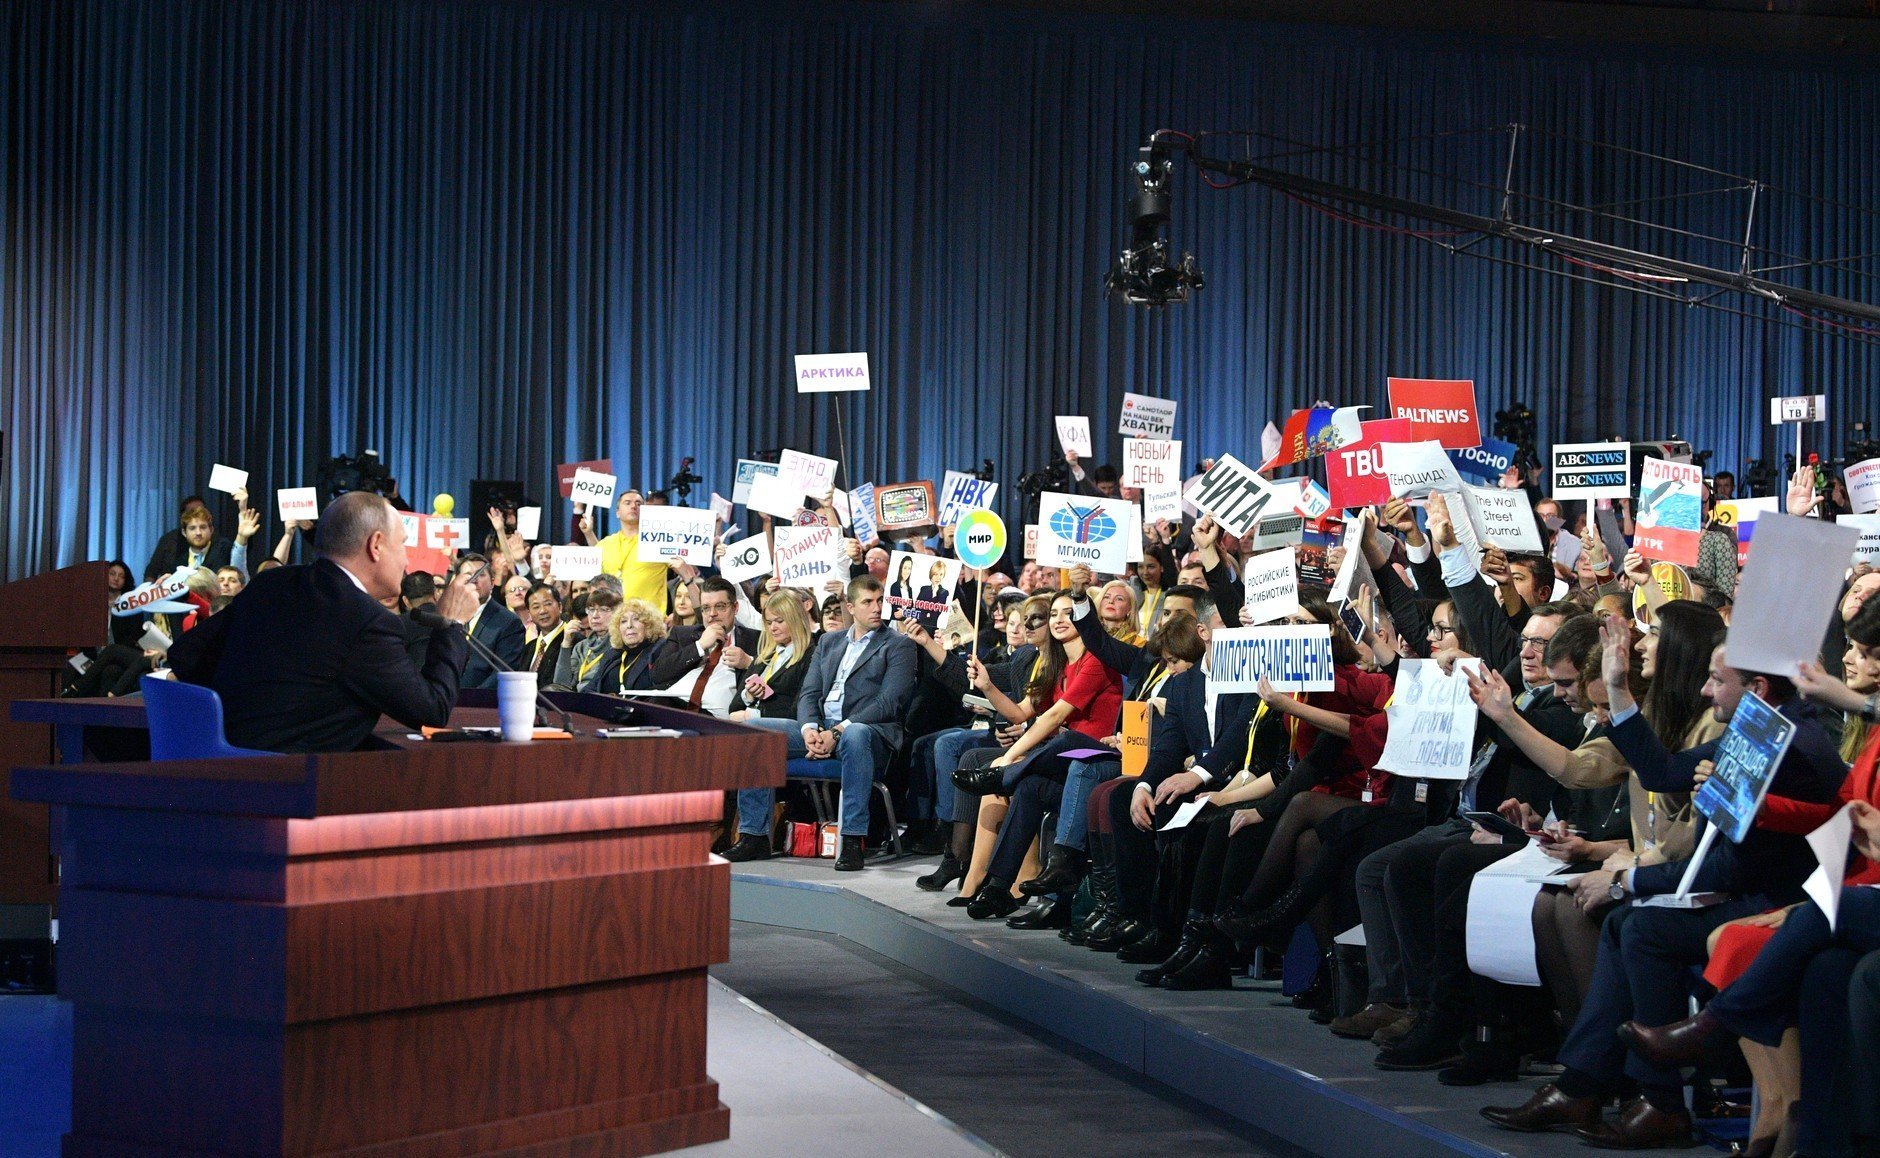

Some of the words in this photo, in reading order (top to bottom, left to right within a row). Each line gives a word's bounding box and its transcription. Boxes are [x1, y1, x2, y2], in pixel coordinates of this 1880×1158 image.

[801, 367, 864, 379] АРКТИКА
[1397, 406, 1469, 424] BALTNEWS
[1058, 426, 1088, 443] УФА
[1122, 418, 1172, 435] ХВАТИТ
[1129, 440, 1171, 460] НОВЫЙ
[1133, 465, 1164, 486] ДЕНЬ
[1390, 468, 1447, 486] ГЕНОЦИД!
[951, 477, 993, 508] НВК
[1196, 460, 1272, 534] ЧИТА
[1475, 495, 1491, 507] The
[1494, 496, 1517, 508] Wall
[1483, 510, 1513, 522] Street
[640, 531, 712, 547] КУЛЬТУРА
[968, 534, 992, 544] МИР
[1485, 525, 1521, 536] Journal
[1057, 544, 1101, 560] МГИМО
[1247, 566, 1290, 588] РОССИЙСКИЕ
[1211, 638, 1334, 692] ИМПОРТОЗАМЕЩЕНИЕ
[1725, 731, 1769, 779] БОЛЬШАЯ
